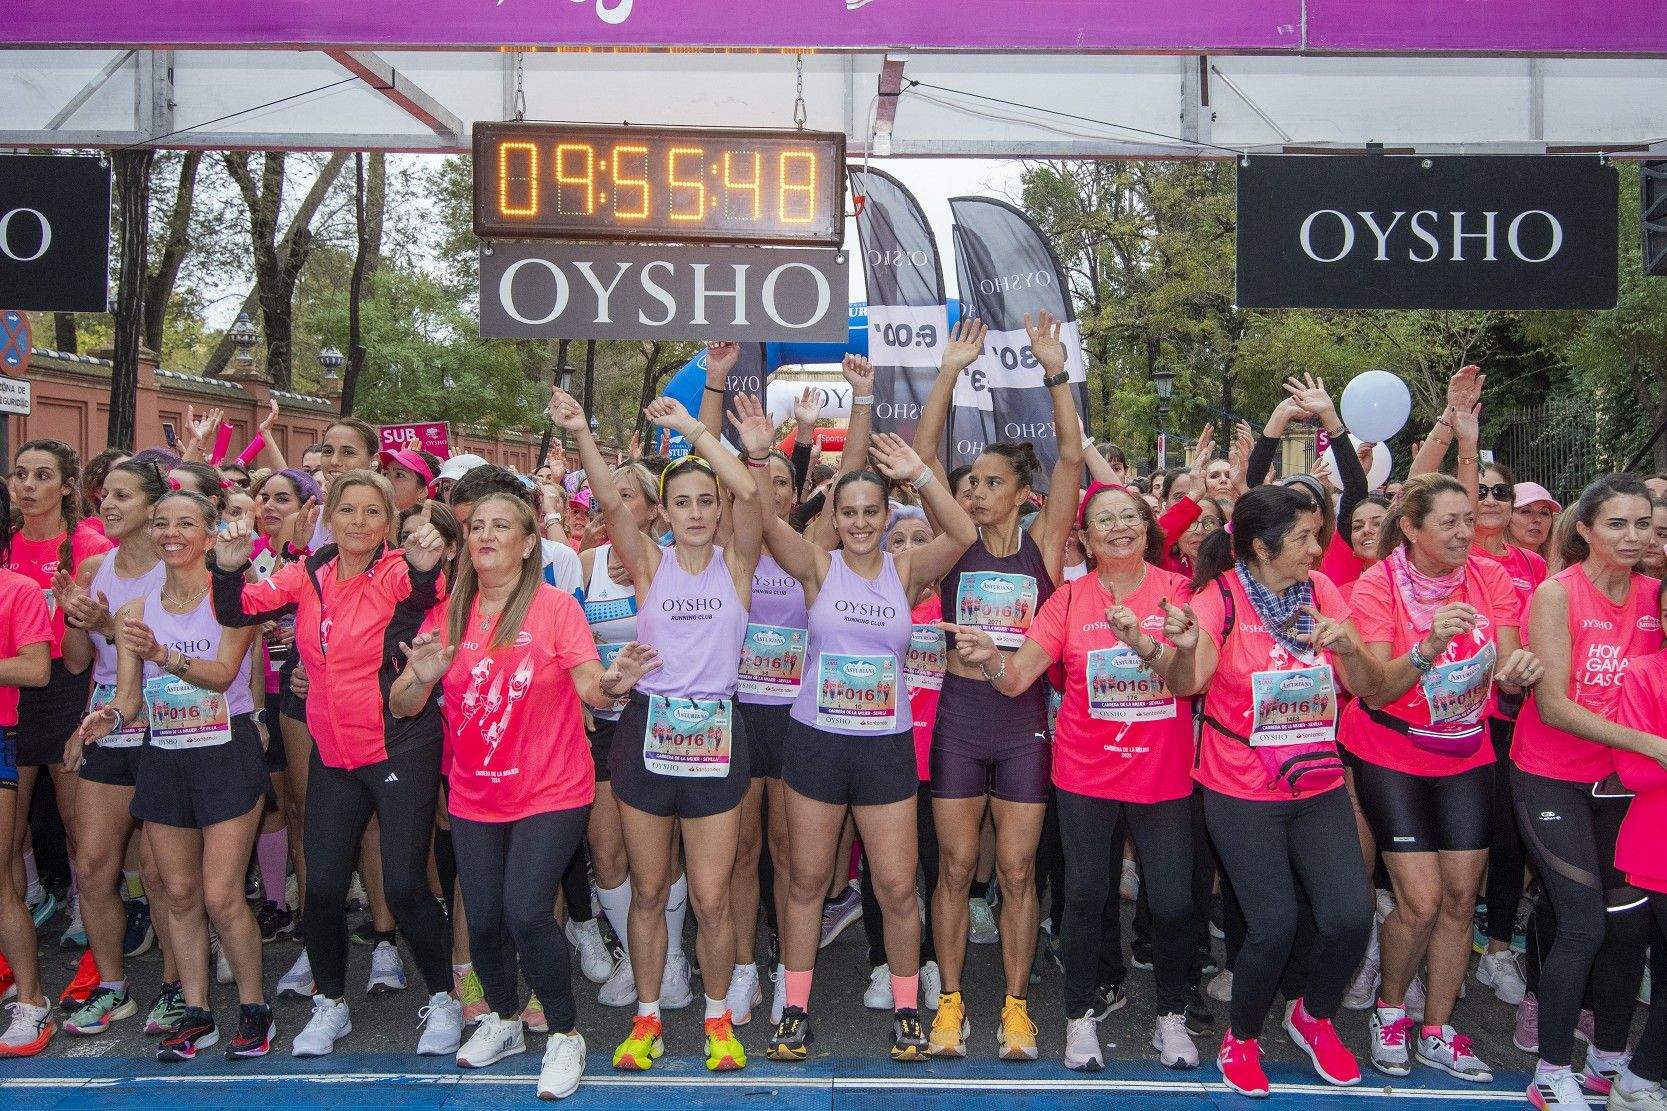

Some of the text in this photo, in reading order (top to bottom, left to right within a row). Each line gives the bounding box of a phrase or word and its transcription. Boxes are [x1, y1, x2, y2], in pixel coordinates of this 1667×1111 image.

[499, 142, 816, 224] 09:55:48
[1300, 209, 1563, 263] OYSHO
[499, 257, 831, 329] OYSHO
[383, 428, 417, 443] SUB
[662, 598, 722, 612] OYSHO
[835, 599, 896, 620] OYSHO
[843, 616, 886, 628] RUNNING CLUB
[1587, 643, 1621, 659] HOY
[1117, 680, 1149, 692] 016
[1583, 671, 1613, 687] LAS
[845, 688, 875, 701] 016
[170, 705, 200, 720] 016
[1278, 700, 1310, 714] 016
[825, 716, 851, 724] OYSHO
[673, 733, 705, 746] 016
[1259, 734, 1288, 742] OYSHO
[652, 762, 679, 771] OYSHO
